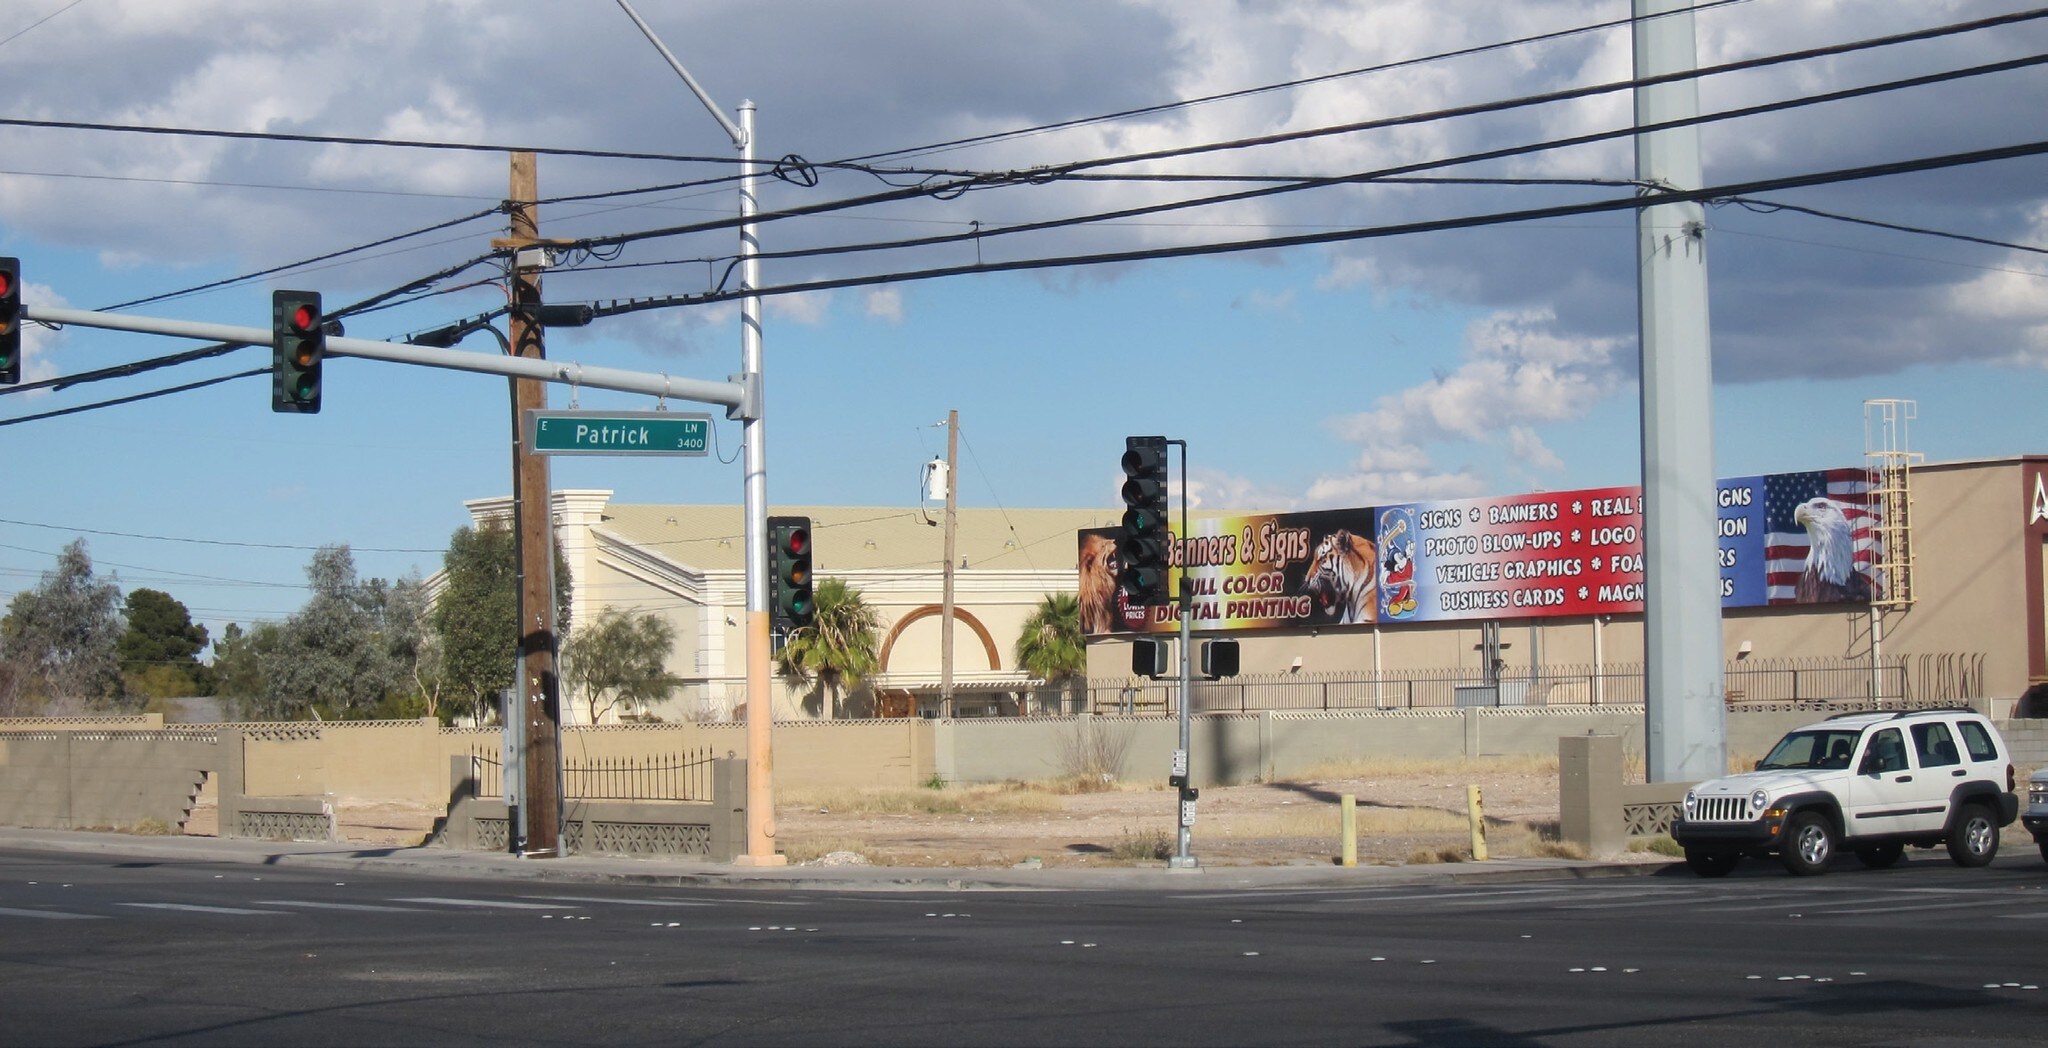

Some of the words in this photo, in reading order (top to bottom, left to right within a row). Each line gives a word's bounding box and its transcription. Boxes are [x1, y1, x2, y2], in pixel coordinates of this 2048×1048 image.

[541, 421, 548, 431] E
[576, 424, 649, 444] Patrick
[685, 424, 698, 433] LN
[677, 438, 703, 448] 3400
[1420, 509, 1461, 530] SIGNS
[1488, 502, 1558, 525] BANNERS
[1590, 496, 1634, 518] REAL
[1168, 531, 1236, 568] Banners
[1241, 525, 1255, 567] &
[1258, 519, 1310, 570] Signs
[1425, 536, 1478, 557] PHOTO
[1482, 530, 1562, 554] BLOW-UPS
[1590, 525, 1636, 546] LOGO
[1436, 562, 1500, 583] VEHICLE
[1503, 557, 1582, 579] GRAPHICS
[1611, 553, 1644, 573] FOA
[1190, 576, 1217, 596] ULL
[1222, 572, 1284, 595] COLOR
[1155, 601, 1220, 622] DIGTAL
[1226, 596, 1311, 620] PRINTING
[1440, 590, 1509, 611] BUSINESS
[1512, 587, 1565, 607] CARDS
[1125, 611, 1146, 619] PRICES
